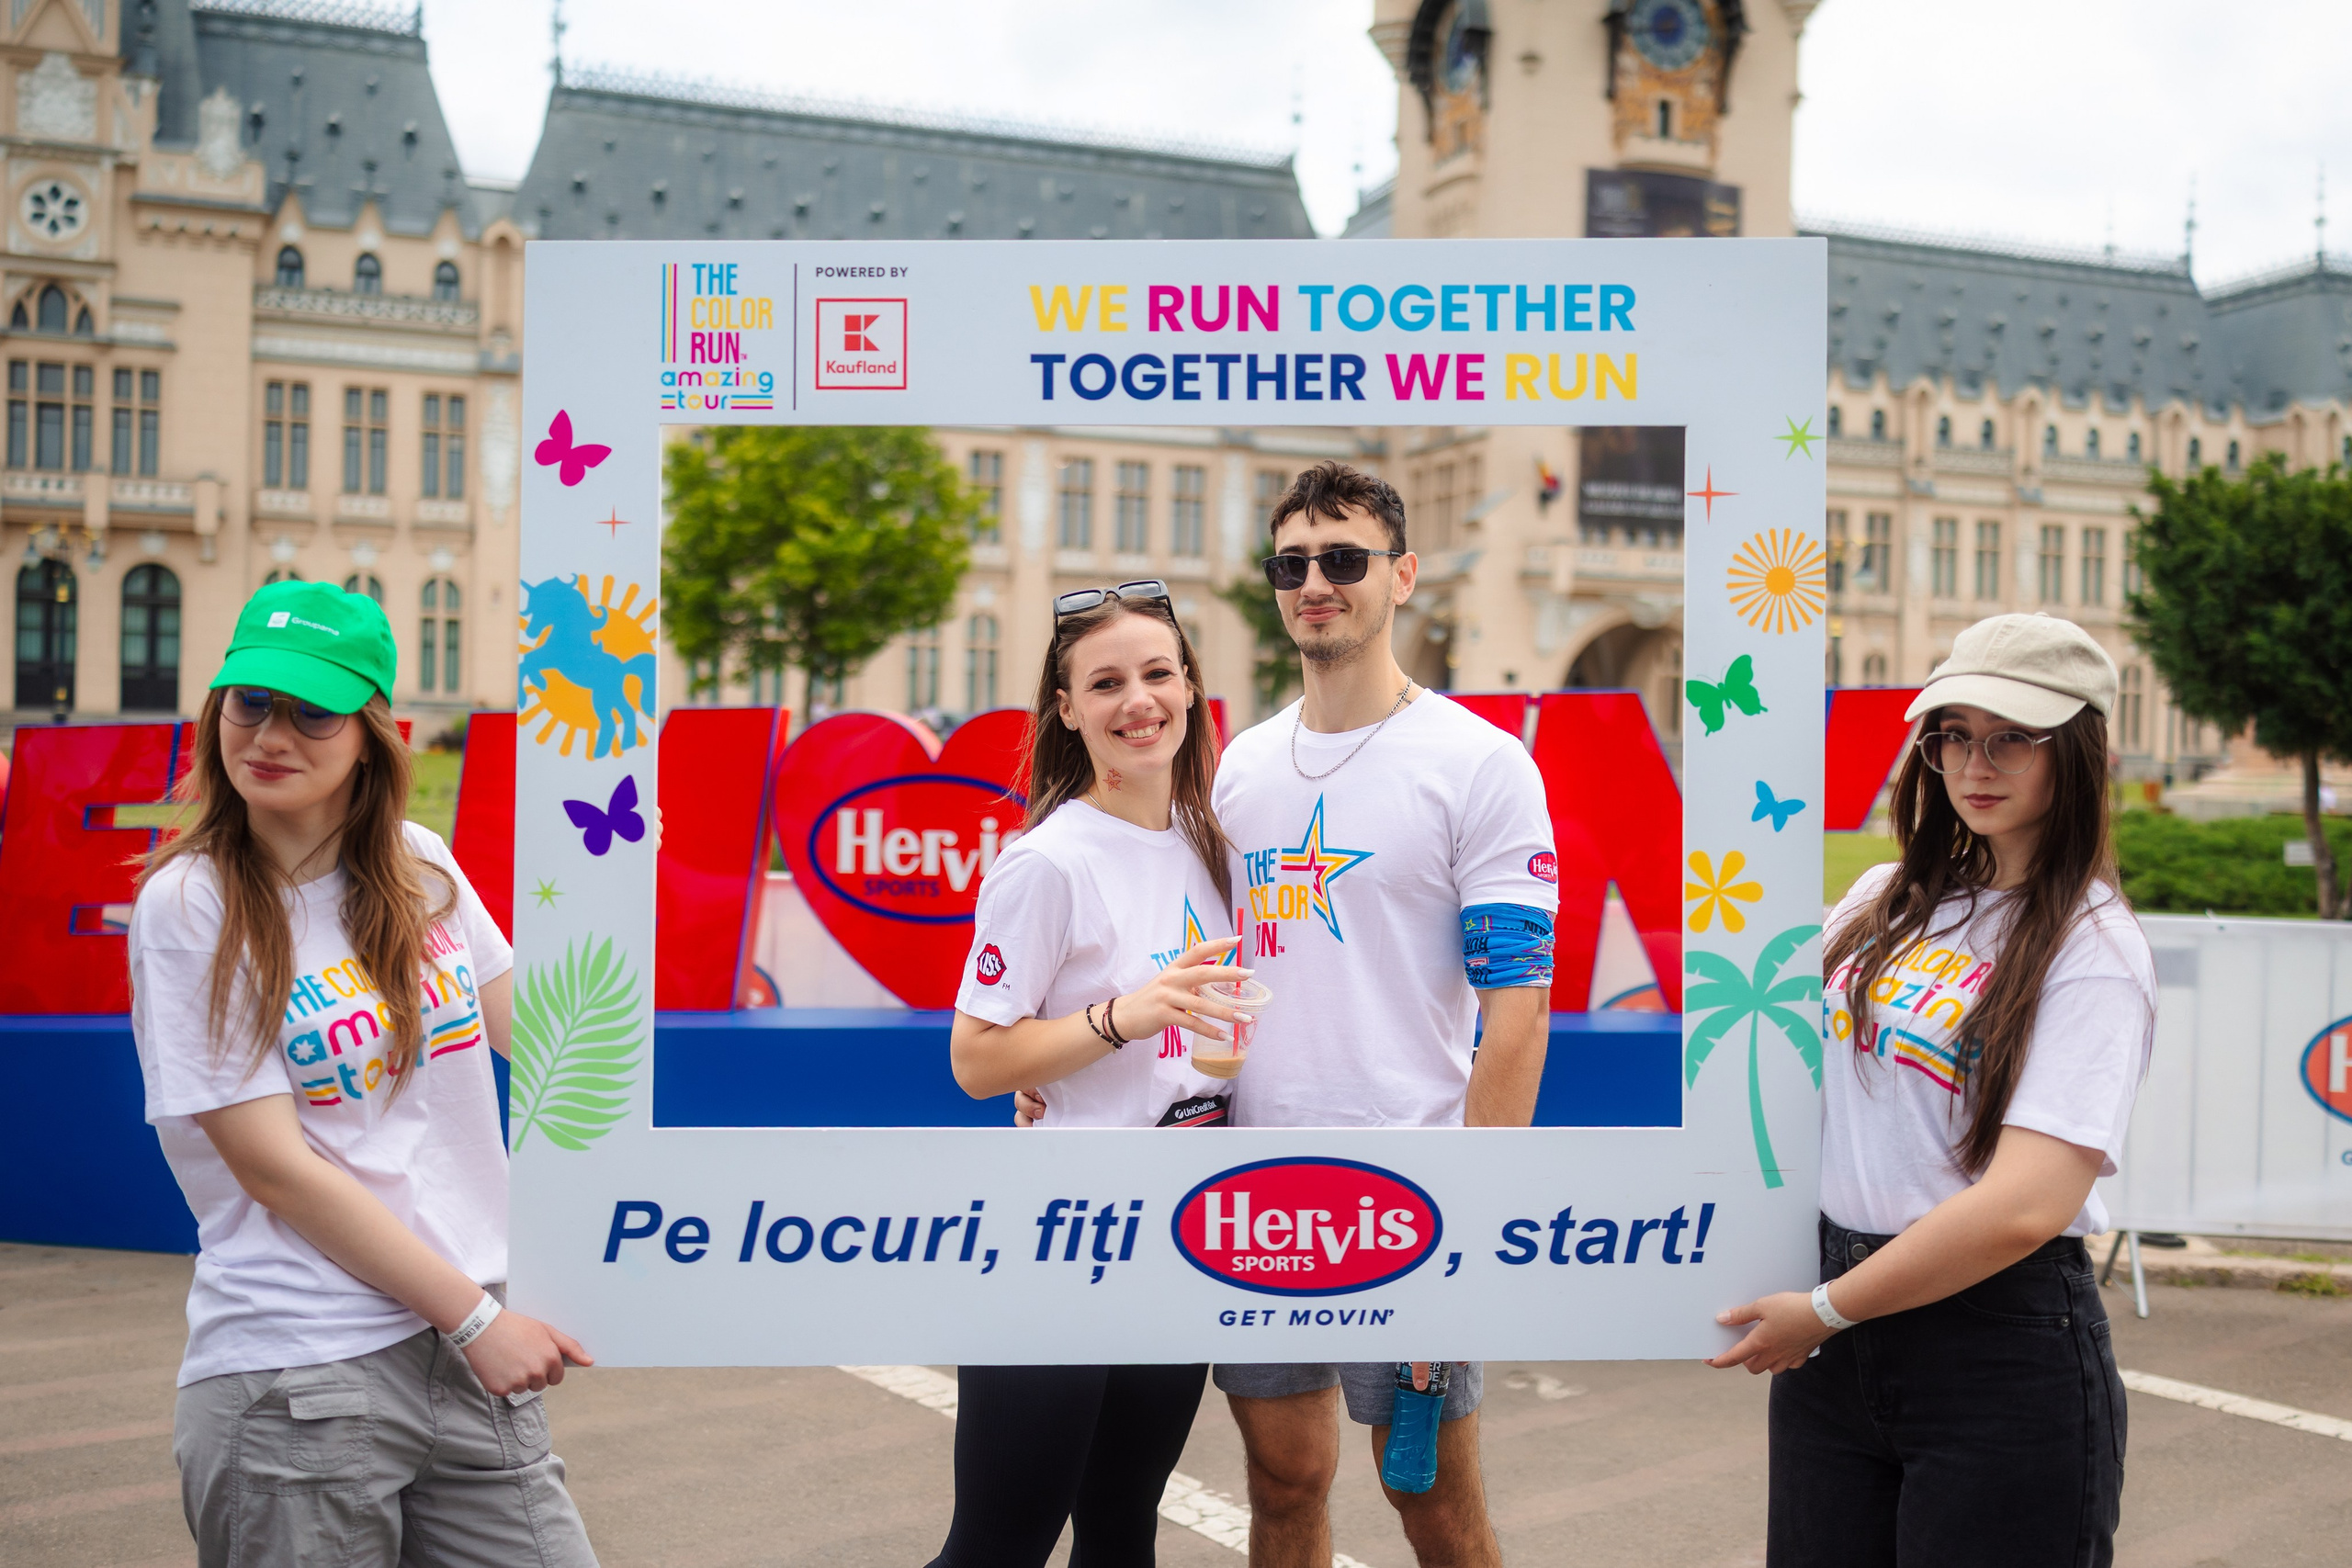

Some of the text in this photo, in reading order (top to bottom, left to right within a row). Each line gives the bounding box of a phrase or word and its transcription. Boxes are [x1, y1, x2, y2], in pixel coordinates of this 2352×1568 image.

[692, 264, 738, 295] THE
[816, 266, 909, 277] POWERED BY
[691, 298, 774, 330] COLOR
[1028, 284, 1636, 333] WE RUN TOGETHER
[826, 360, 897, 374] Kaufland
[1030, 353, 1638, 401] TOGETHER WE RUN
[661, 367, 774, 393] amazing
[678, 390, 728, 410] tour
[1244, 848, 1277, 887] THE
[863, 879, 940, 897] SPORTS
[1183, 1102, 1208, 1117] UniCredit
[603, 1200, 711, 1264] Pe
[738, 1200, 999, 1275] locuri,
[1035, 1199, 1145, 1284] fiți
[1204, 1191, 1419, 1265] Hervis
[1495, 1202, 1716, 1265] start!
[1232, 1256, 1315, 1272] SPORTS
[1218, 1309, 1276, 1326] GET
